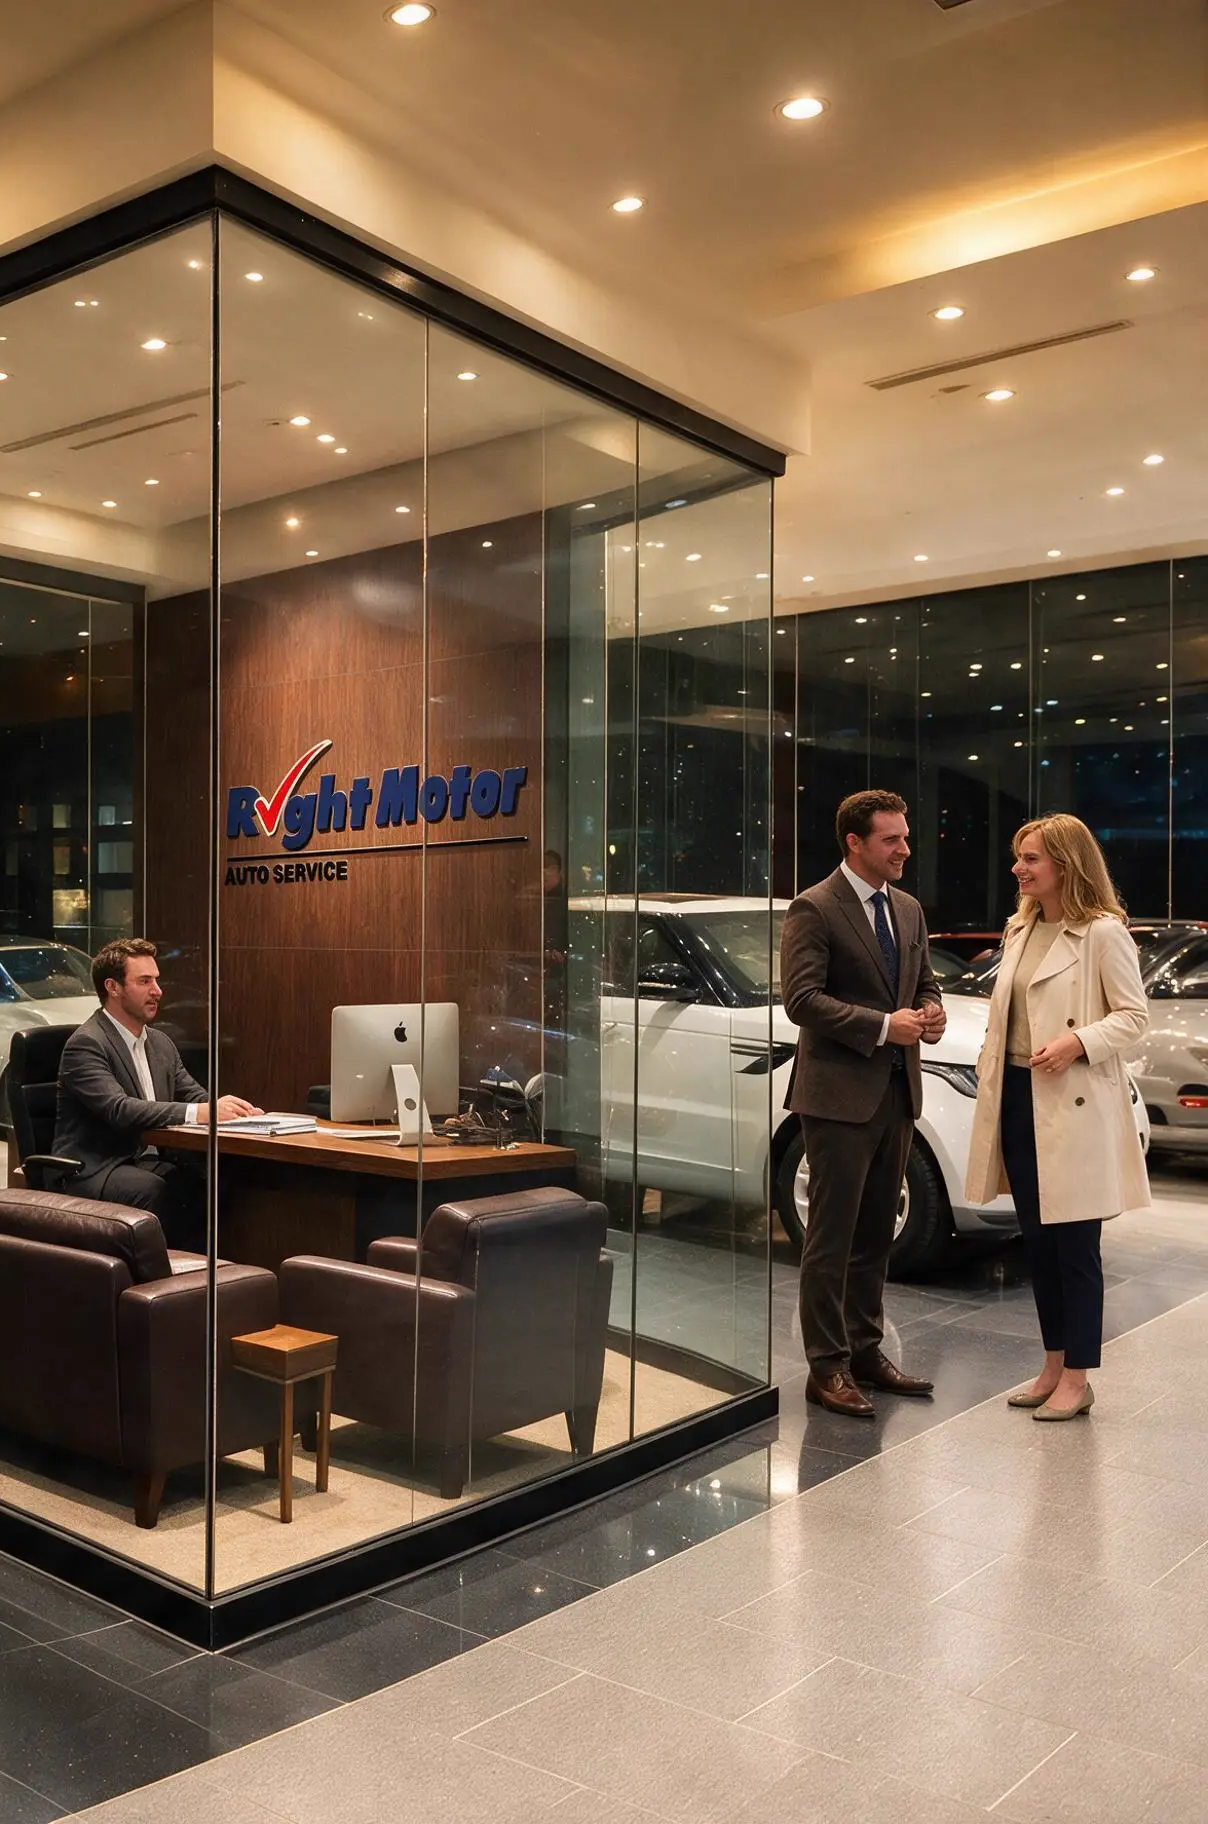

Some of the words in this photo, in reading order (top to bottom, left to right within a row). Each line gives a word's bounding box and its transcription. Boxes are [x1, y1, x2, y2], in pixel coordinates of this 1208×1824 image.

[375, 764, 528, 829] Motor
[224, 865, 270, 886] AUTO
[272, 860, 348, 884] SERVICE
